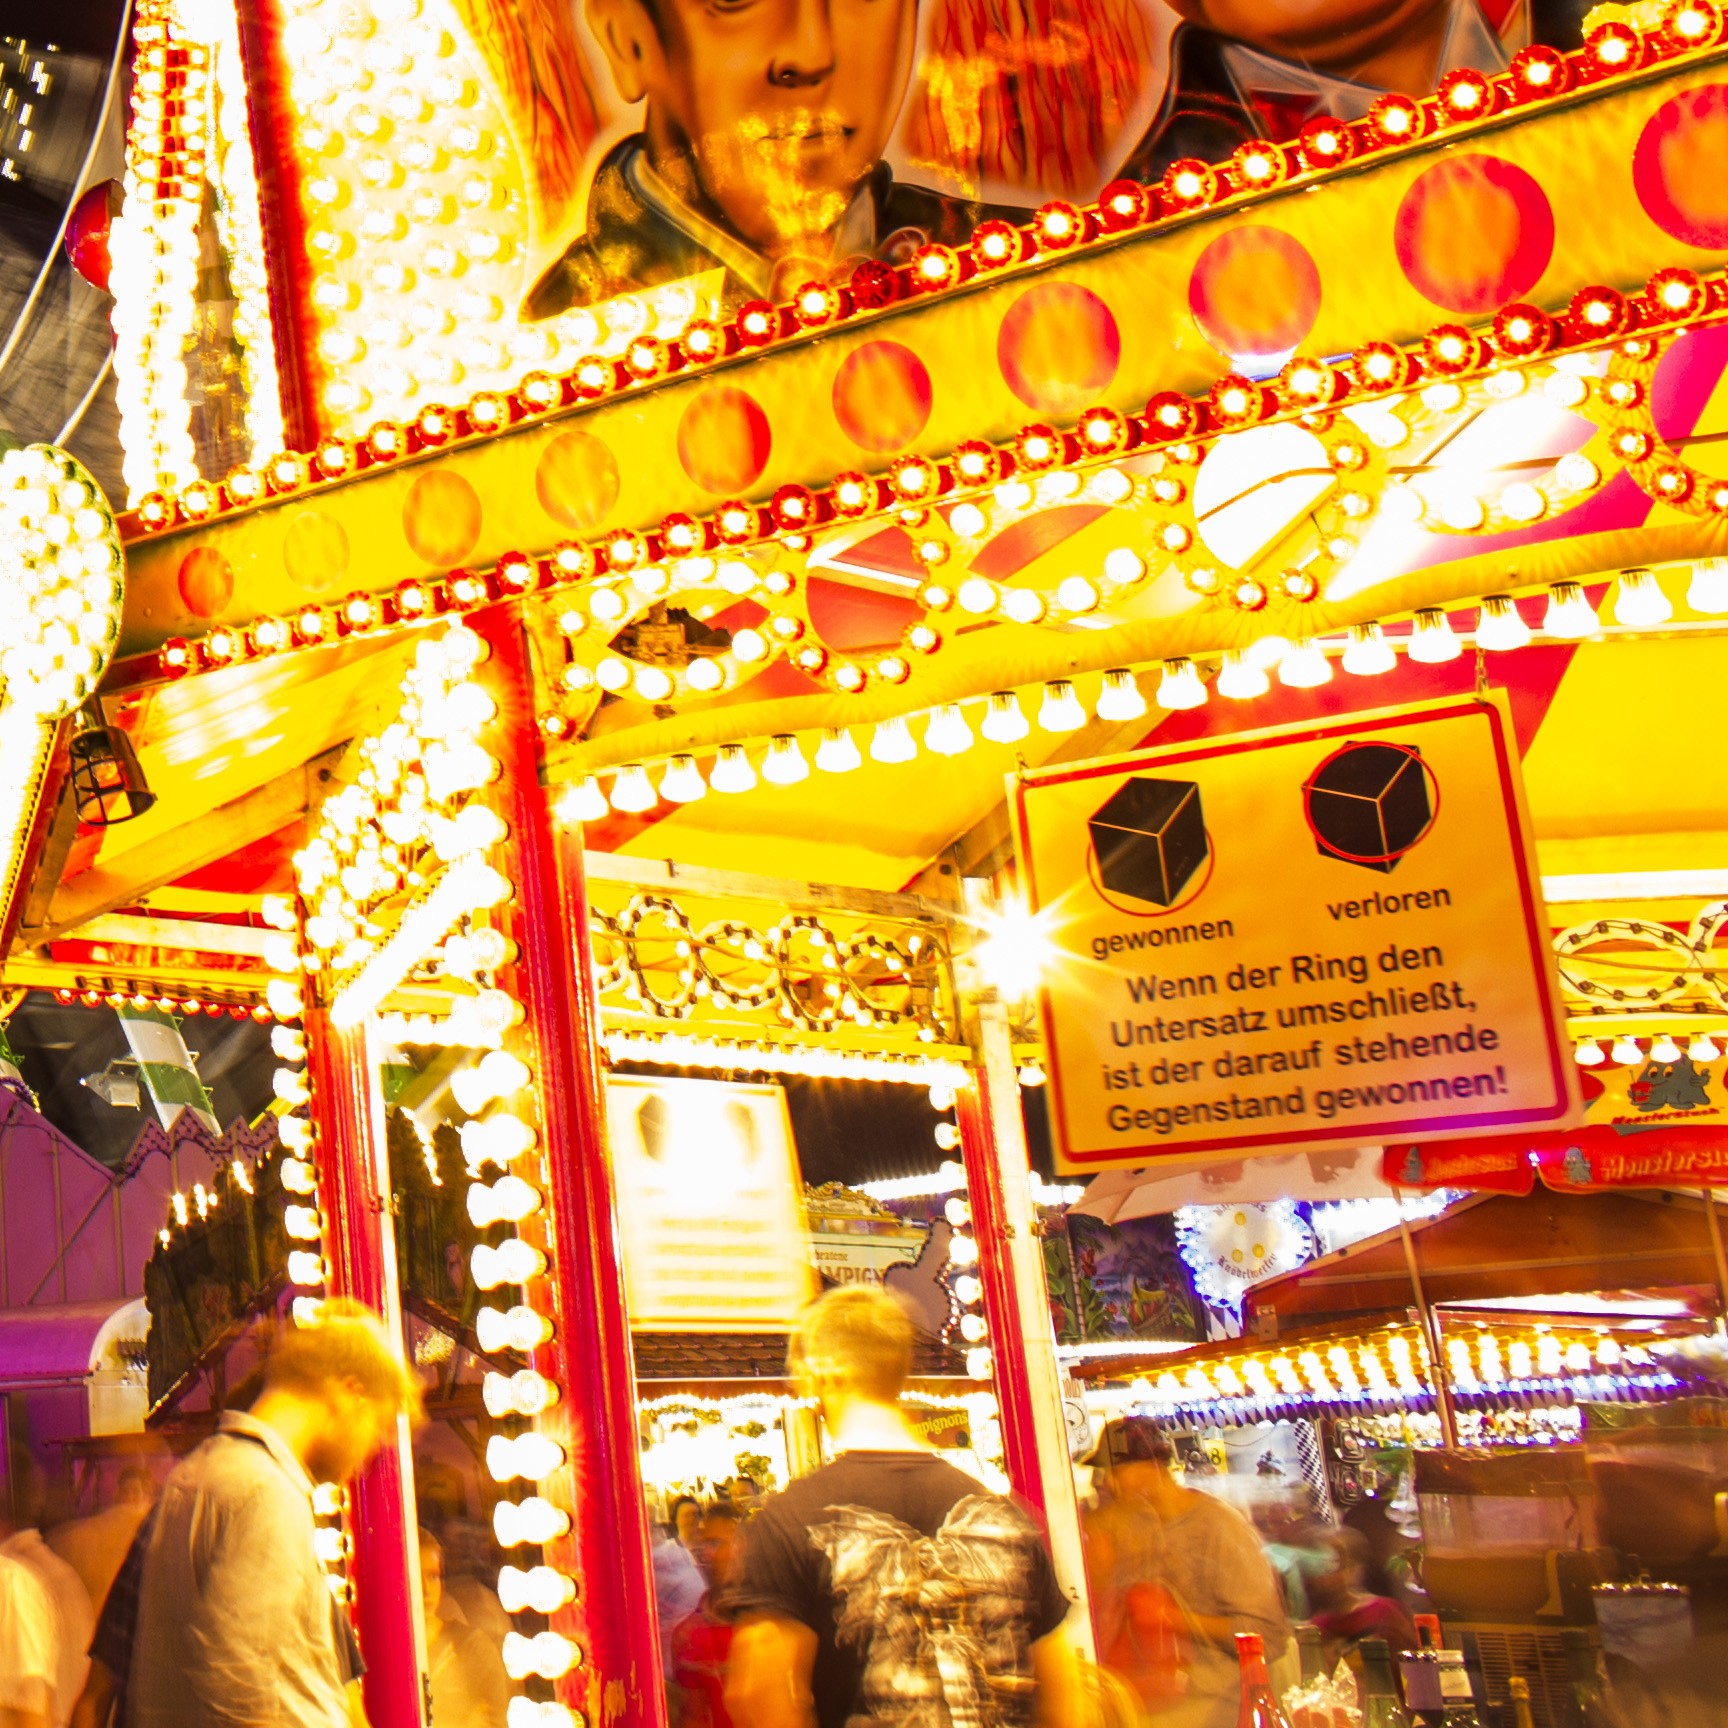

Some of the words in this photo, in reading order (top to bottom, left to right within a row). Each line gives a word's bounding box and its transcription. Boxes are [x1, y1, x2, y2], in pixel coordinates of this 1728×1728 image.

[1327, 885, 1452, 921] verloren
[1091, 916, 1234, 960] gewonnen
[1126, 974, 1217, 1004] Wenn
[1226, 963, 1279, 993] der
[1291, 953, 1369, 986] Ring
[1378, 942, 1444, 974] den
[1111, 1005, 1266, 1049] Untersatz
[1277, 981, 1477, 1030] umschließt,
[1102, 1061, 1144, 1091] ist
[1150, 1053, 1202, 1087] der
[1214, 1040, 1323, 1080] darauf
[1336, 1024, 1500, 1066] stehende
[1107, 1086, 1305, 1136] Gegenstand
[1315, 1065, 1508, 1118] gewonnen!
